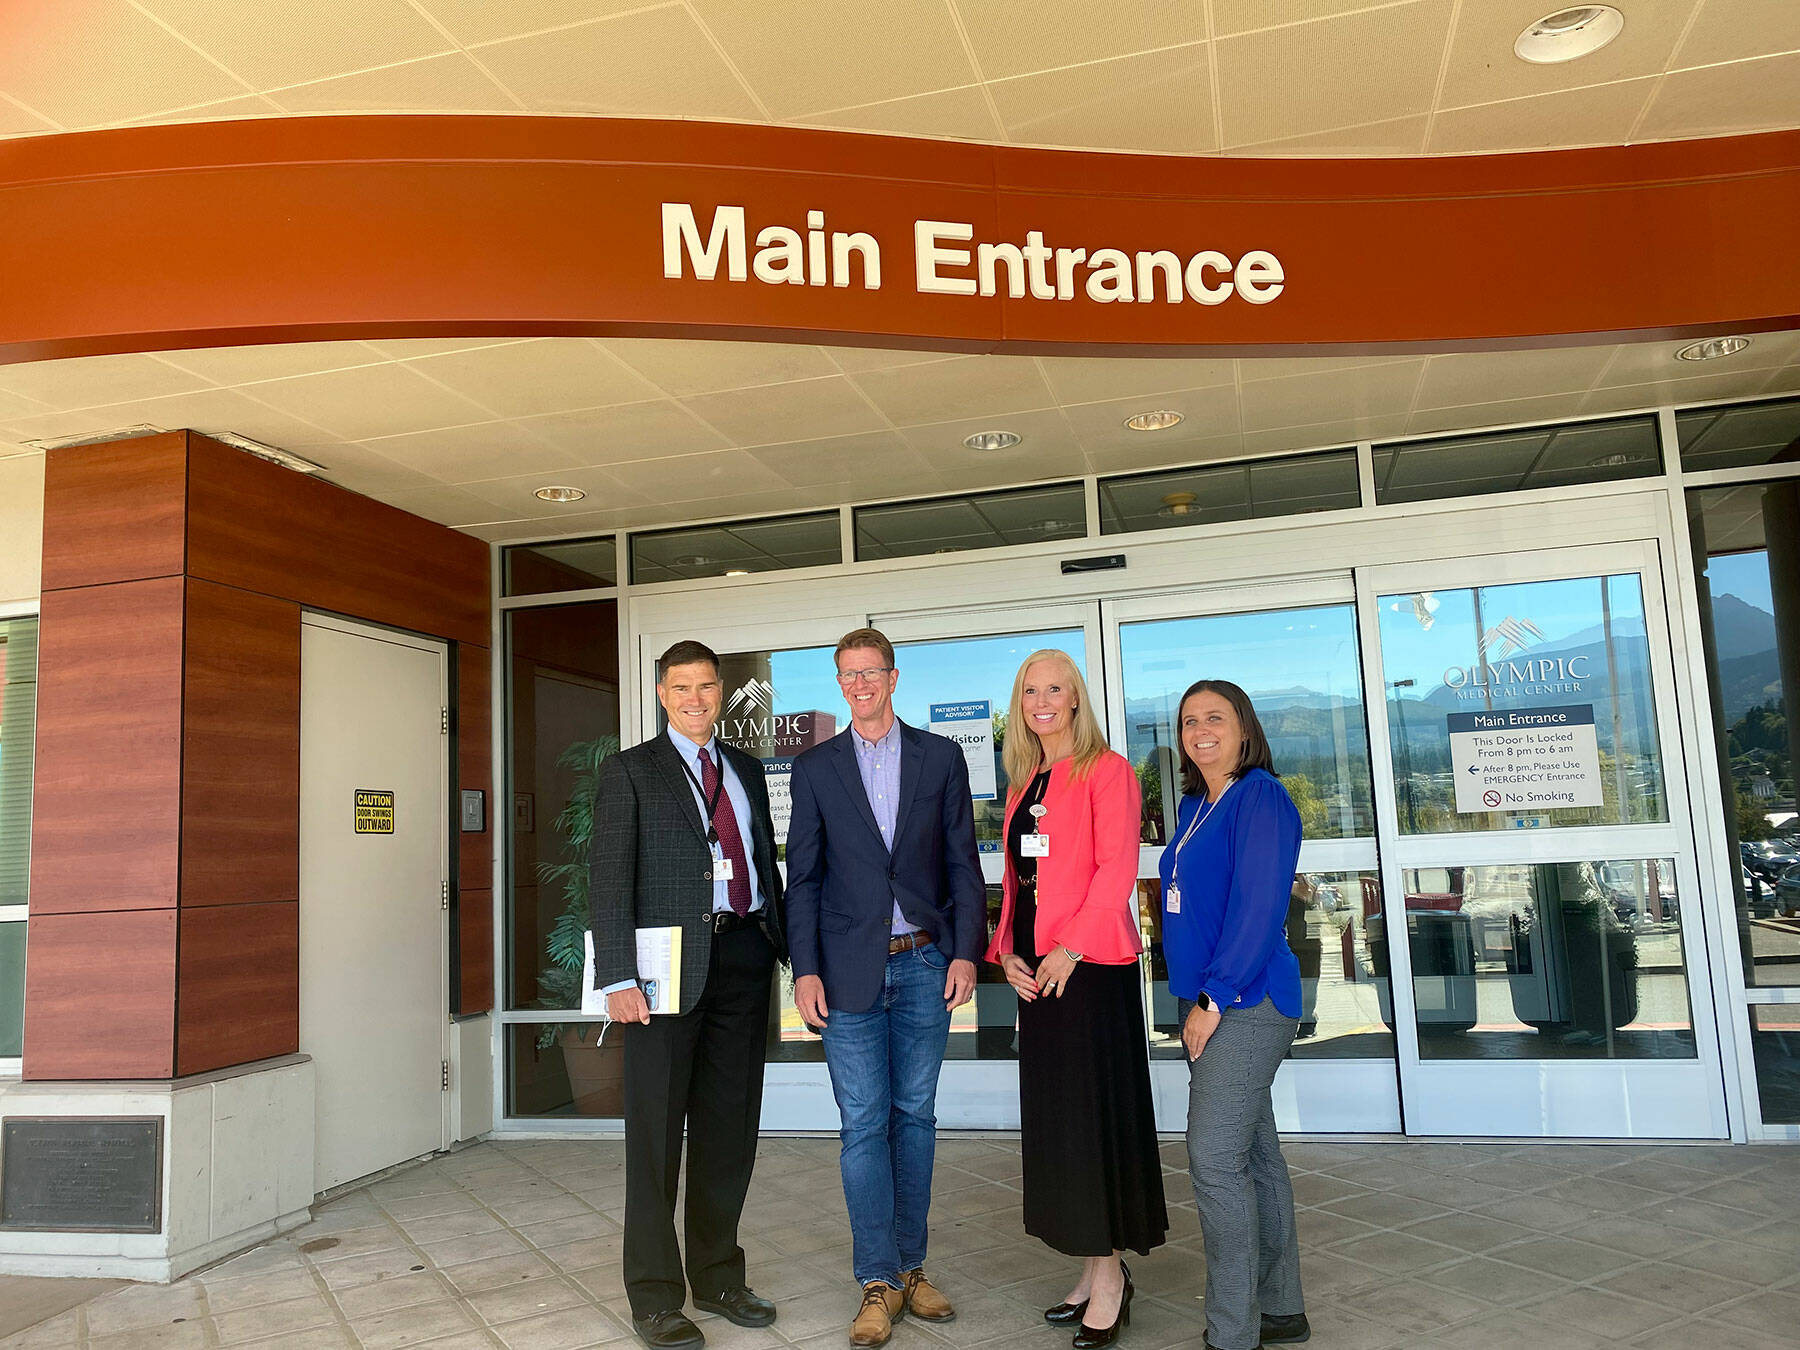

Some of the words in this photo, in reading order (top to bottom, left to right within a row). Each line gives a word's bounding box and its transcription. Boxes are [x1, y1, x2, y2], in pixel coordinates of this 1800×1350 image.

[661, 203, 881, 290] Main
[914, 220, 1285, 305] Entrance
[1443, 655, 1591, 688] OLYMPIC
[1456, 686, 1518, 700] MEDICAL
[1525, 682, 1582, 695] CENTER
[961, 704, 985, 712] VISITOR
[1474, 715, 1505, 727] Main
[1509, 712, 1567, 725] Entrance
[760, 737, 803, 748] CENTER
[1473, 737, 1493, 747] This
[1496, 736, 1523, 745] Door
[1526, 735, 1534, 743] Is
[1537, 732, 1573, 743] Locked
[1478, 749, 1504, 758] From
[1507, 747, 1513, 756] 8
[1516, 748, 1531, 758] pm
[1535, 747, 1546, 755] to
[1549, 745, 1555, 753] 6
[1559, 745, 1573, 753] am
[1482, 765, 1504, 774] After
[1507, 764, 1514, 772] 8
[1533, 762, 1560, 771] Please
[1563, 761, 1580, 769] Use
[1484, 773, 1544, 784] EMERGENCY
[1547, 772, 1585, 781] Entrance
[358, 794, 391, 806] CAUTION
[1505, 793, 1524, 803] No
[1527, 791, 1574, 802] Smoking
[358, 809, 372, 818] DOOR
[372, 809, 391, 818] SWINGS
[358, 818, 391, 830] OUTWARD
